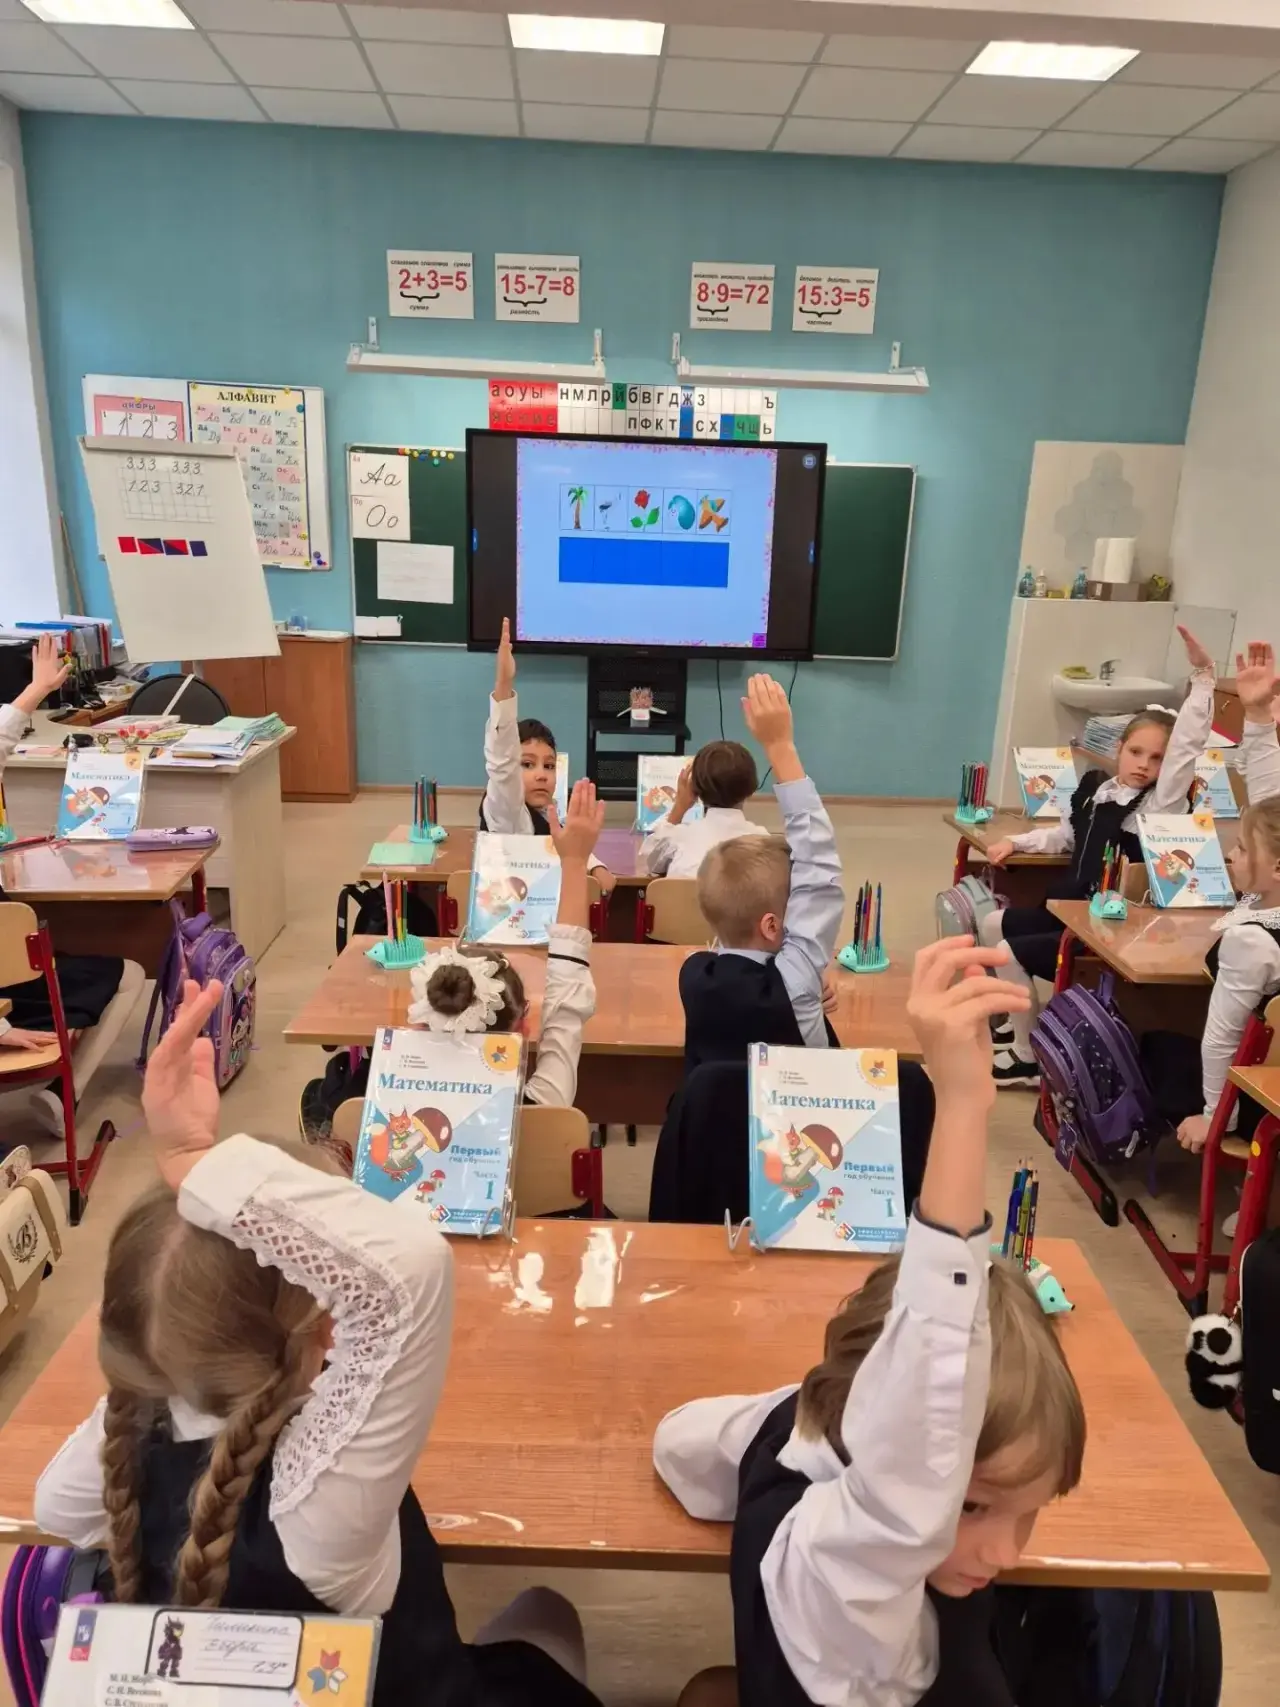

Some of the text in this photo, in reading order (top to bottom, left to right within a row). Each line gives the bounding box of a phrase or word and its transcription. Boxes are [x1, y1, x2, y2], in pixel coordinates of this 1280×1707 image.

[398, 268, 468, 291] 2+3=5
[500, 273, 574, 296] 15-7=8
[798, 284, 870, 308] 15:3=5
[217, 391, 276, 404] АЛФАВИТ
[72, 772, 130, 780] Математика
[1146, 834, 1206, 842] Математика
[378, 1073, 492, 1094] Математика
[450, 1145, 502, 1157] Первый
[844, 1162, 894, 1174] Первый
[486, 1181, 494, 1200] 1
[886, 1198, 894, 1218] 1
